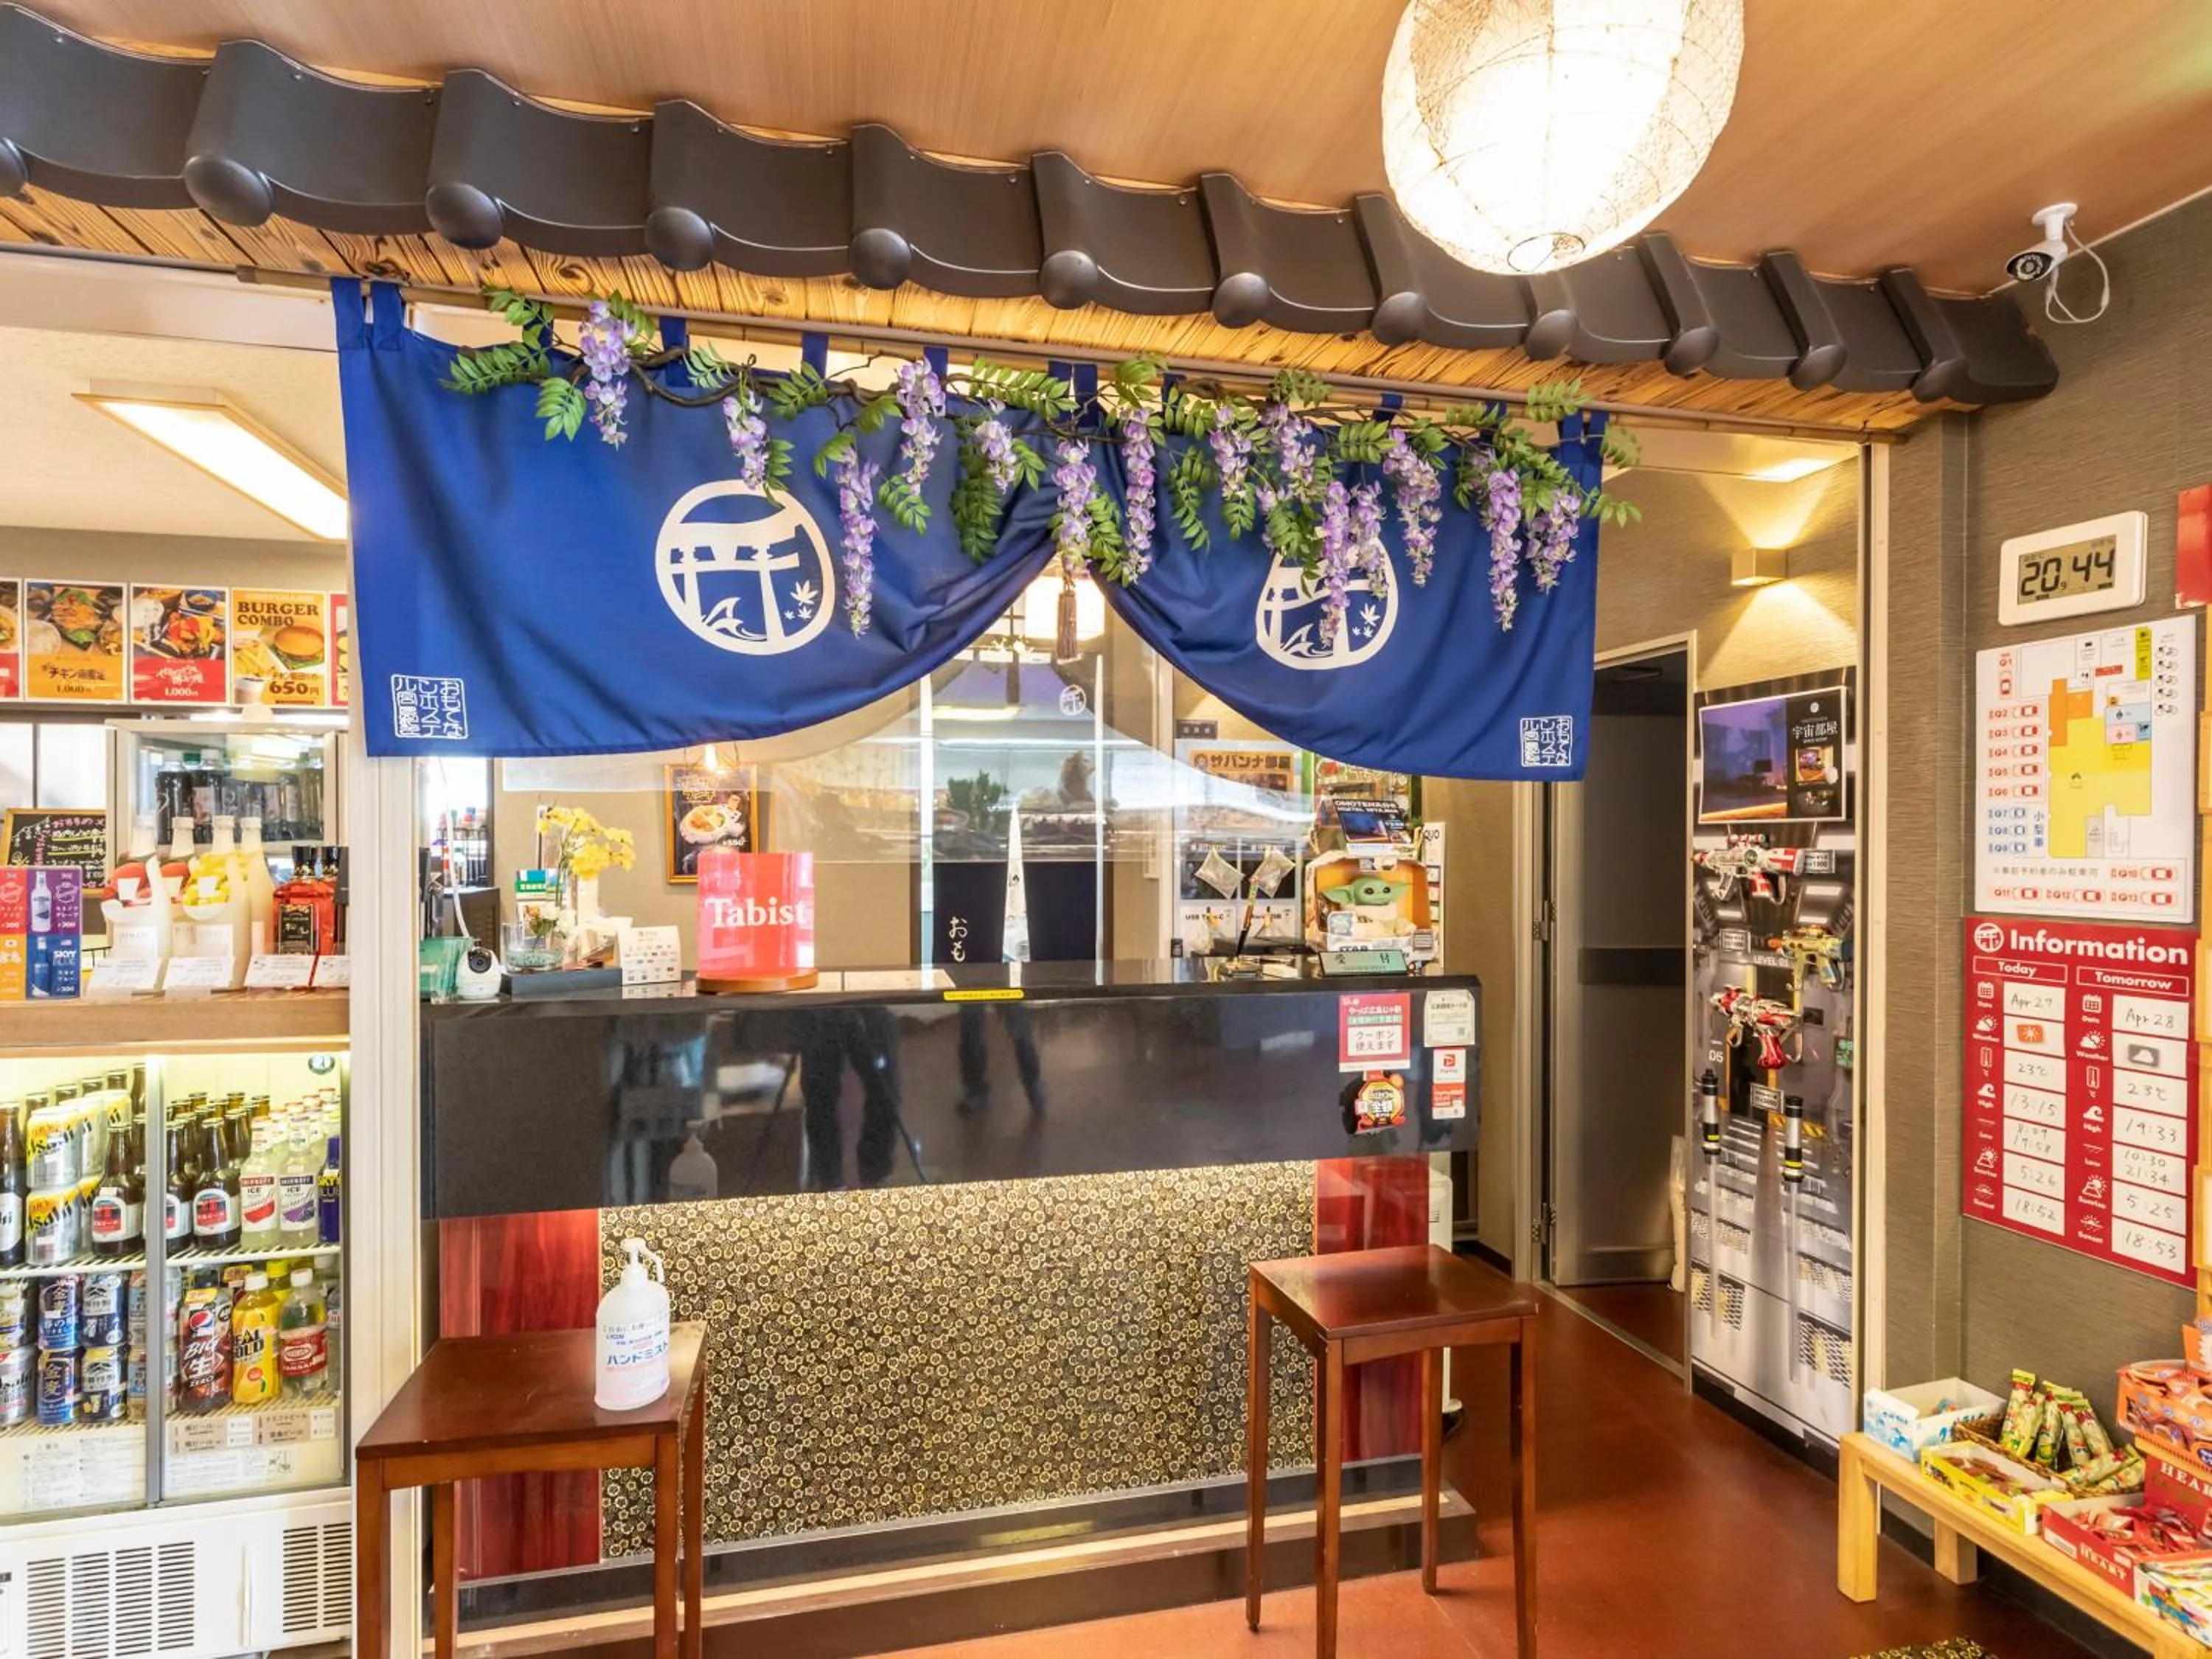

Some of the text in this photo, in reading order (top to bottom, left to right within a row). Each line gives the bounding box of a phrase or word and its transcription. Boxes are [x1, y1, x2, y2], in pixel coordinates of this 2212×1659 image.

[237, 602, 319, 616] BURGER
[237, 614, 294, 626] COMBO
[705, 897, 806, 928] Tabist
[2010, 929, 2188, 965] Information
[1997, 961, 2037, 978] Today
[2095, 971, 2173, 990] Tomorrow
[2011, 992, 2031, 1009] Apr
[2125, 1008, 2174, 1029] Apr 28
